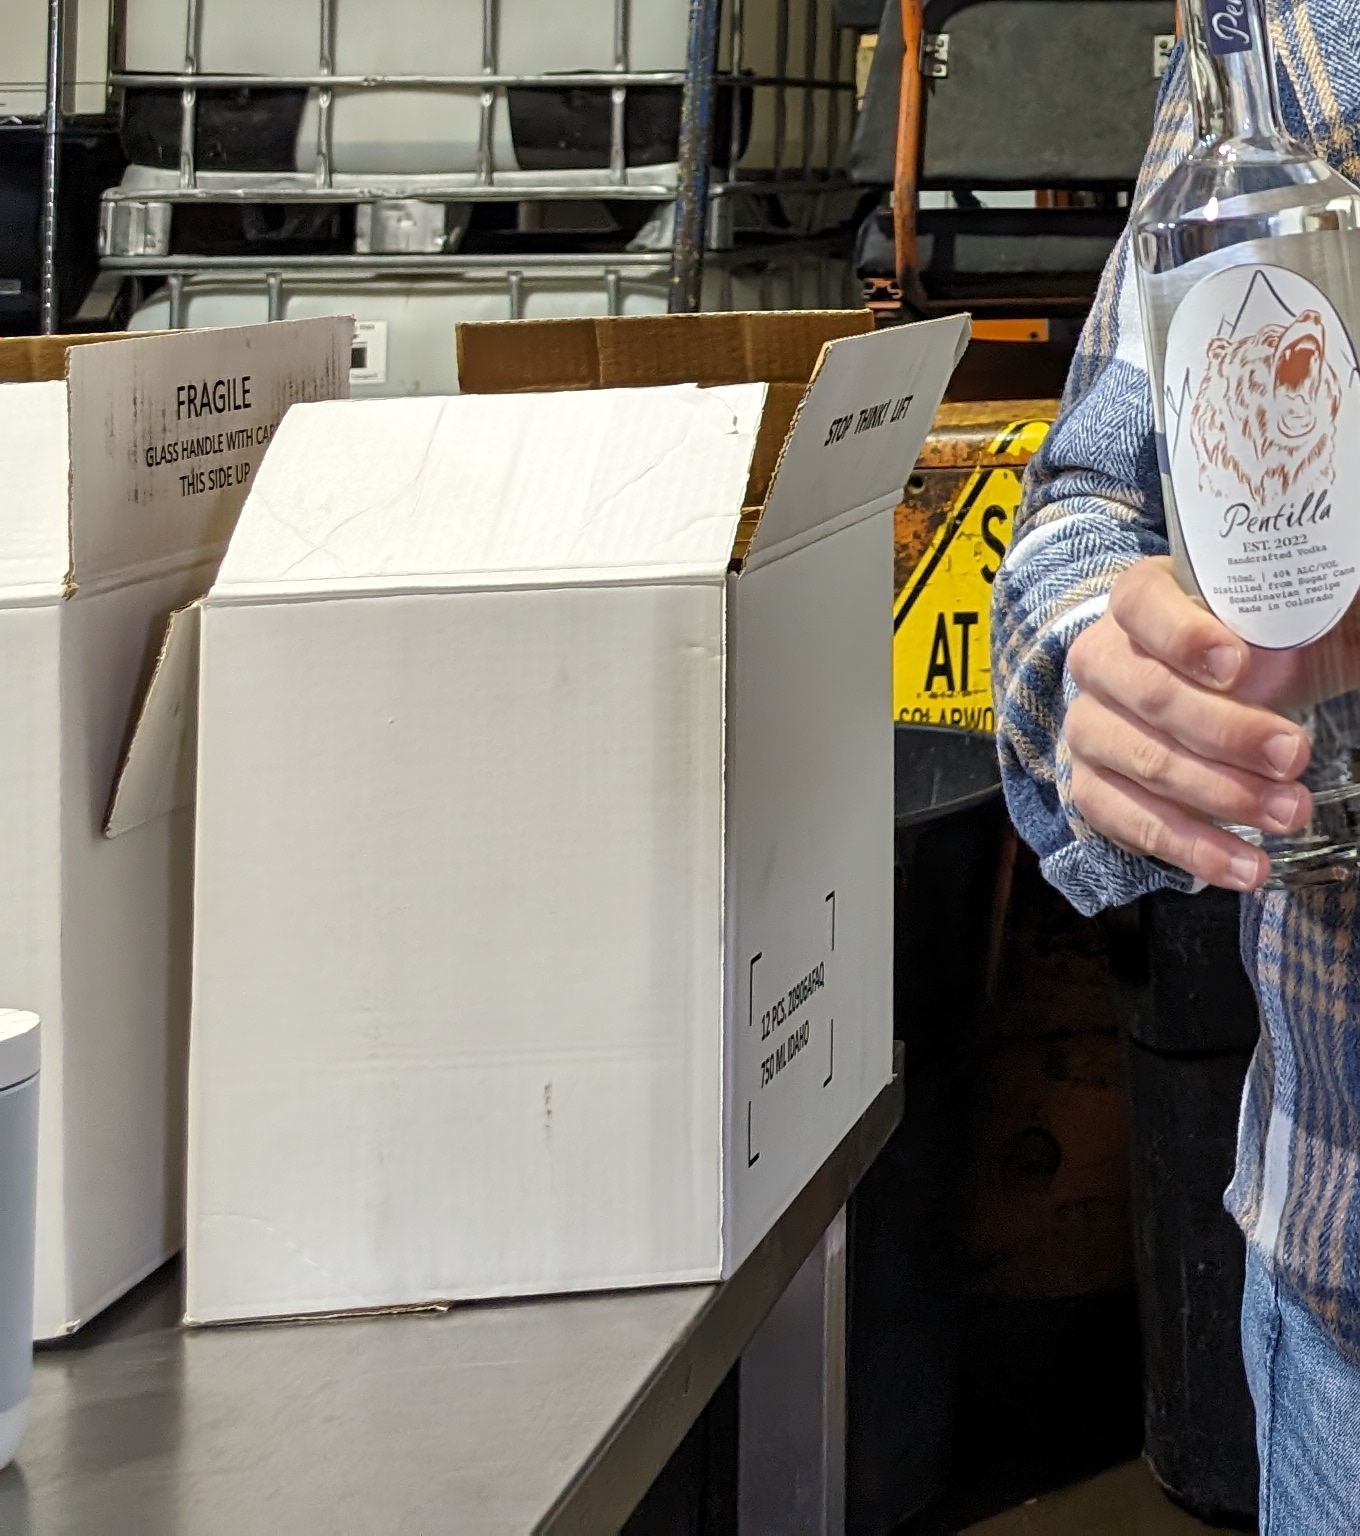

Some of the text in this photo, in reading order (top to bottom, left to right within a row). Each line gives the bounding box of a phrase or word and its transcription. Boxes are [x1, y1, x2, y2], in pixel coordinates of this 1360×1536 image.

[177, 375, 252, 421] FRAGILE
[824, 394, 914, 447] STOP THINK! LIFT
[145, 423, 275, 467] GLASS HANDLE WITH CAR
[179, 462, 251, 497] THIS SIDE UP
[1219, 488, 1332, 538] Pentilla
[1227, 544, 1328, 565] Handcrafted Vodka
[1243, 533, 1309, 553] EST. 2022
[1213, 566, 1356, 595] Distilled from Sugar Cane
[1296, 559, 1339, 575] ALC/VOL
[1229, 580, 1341, 605] Scandinavian recipe
[1238, 602, 1262, 614] Made
[1285, 592, 1334, 608] Colorado
[924, 611, 979, 692] AT
[761, 1010, 770, 1041] 12
[761, 1019, 809, 1089] 750 ML IDAHO
